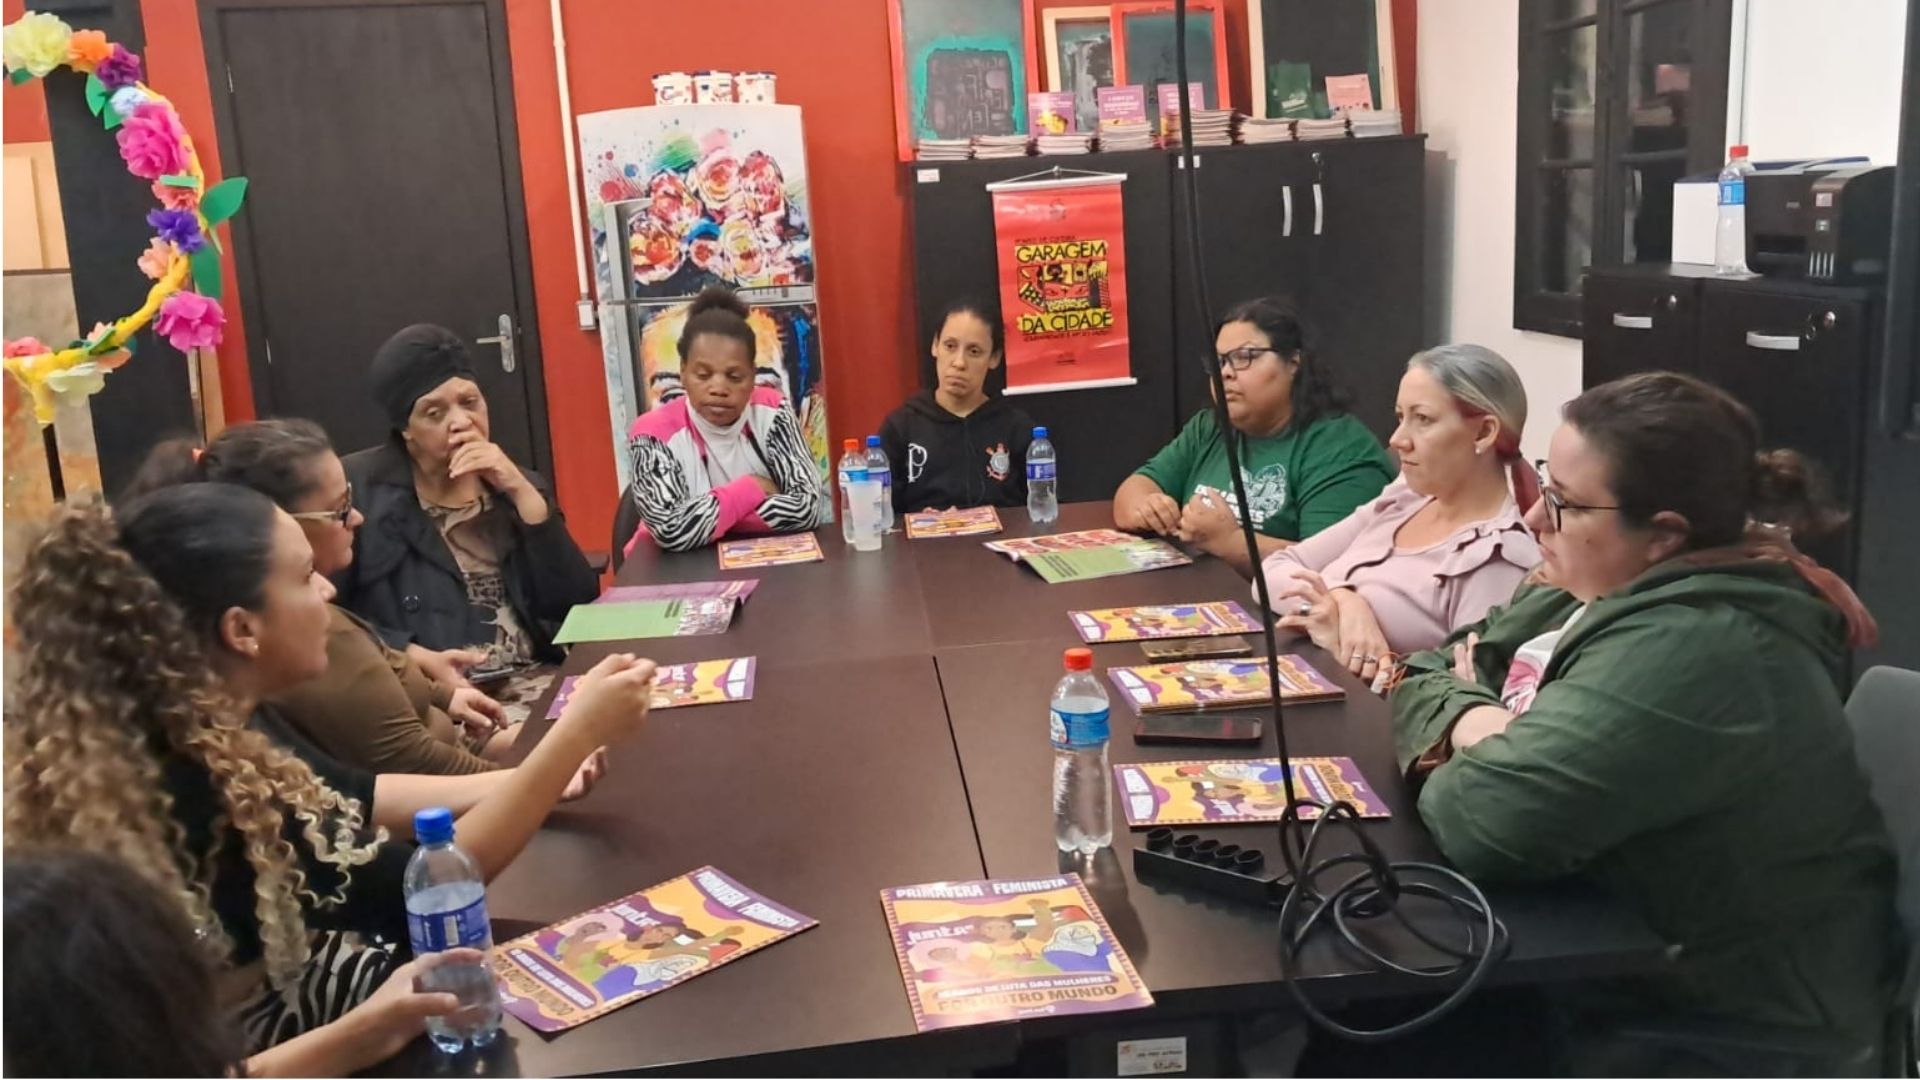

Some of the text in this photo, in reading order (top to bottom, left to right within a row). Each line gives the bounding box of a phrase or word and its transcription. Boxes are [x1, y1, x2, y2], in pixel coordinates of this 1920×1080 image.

[1016, 242, 1106, 262] GARAGEM
[1022, 311, 1112, 333] DA CIDADE
[896, 878, 1068, 899] PRIMAVERA FEMINISTA
[1053, 975, 1112, 987] MULHERES
[1049, 985, 1118, 1002] MUNDO
